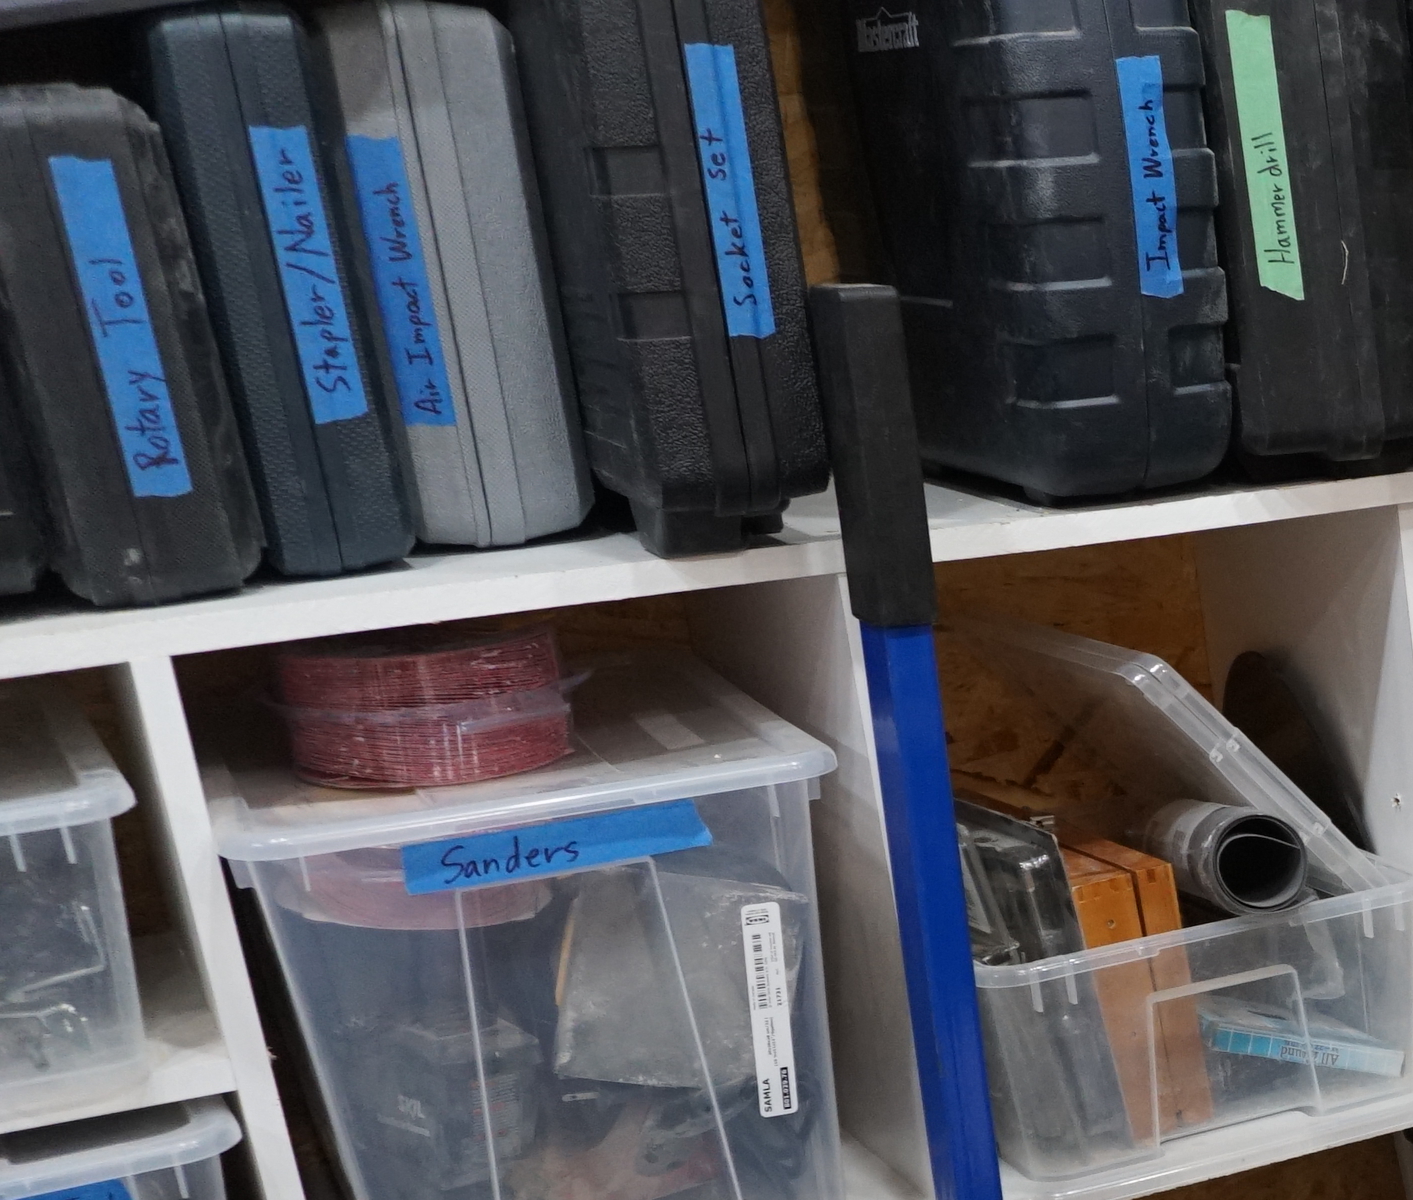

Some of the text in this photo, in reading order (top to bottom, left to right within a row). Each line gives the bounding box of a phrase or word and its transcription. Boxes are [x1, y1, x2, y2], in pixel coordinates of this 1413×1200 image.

[719, 210, 757, 306] Socket
[1138, 99, 1172, 271] Impact Wrench
[1251, 132, 1294, 264] Hammer drill
[274, 149, 351, 393] Stapler/Nailer
[373, 182, 443, 414] Air Impact Wrench
[88, 259, 179, 471] Rotary Tool
[441, 835, 580, 884] Sanders
[761, 1078, 773, 1113] SAMLA
